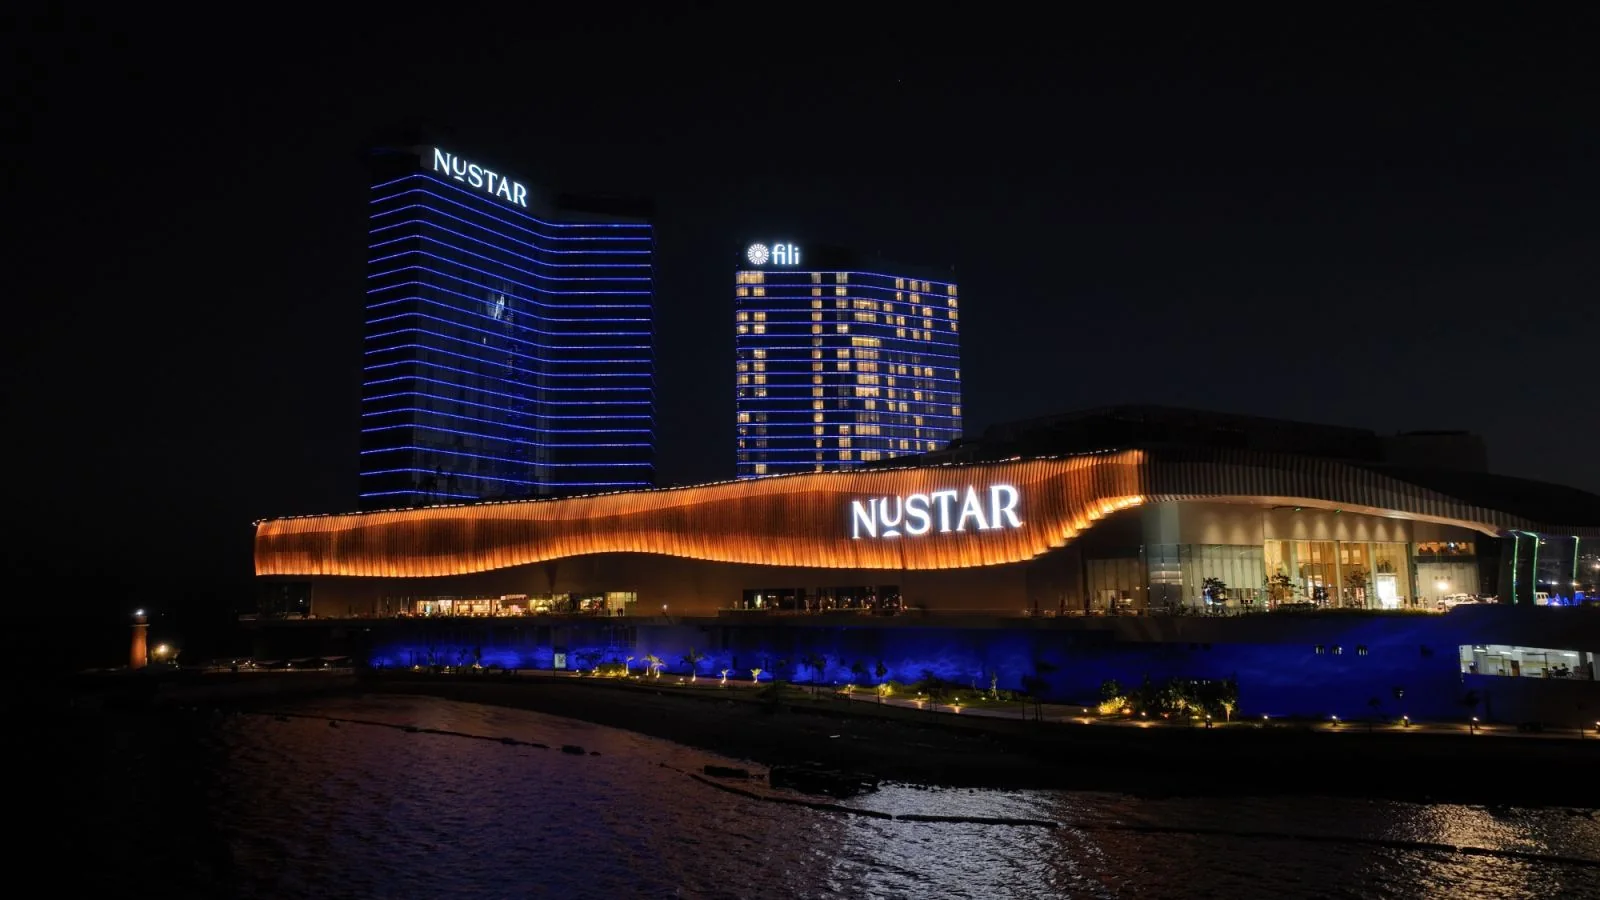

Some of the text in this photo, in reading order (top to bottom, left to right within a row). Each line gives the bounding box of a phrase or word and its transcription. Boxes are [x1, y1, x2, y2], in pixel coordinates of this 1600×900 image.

[433, 147, 528, 208] NUSTAR
[771, 243, 800, 265] fili
[851, 484, 1023, 540] NUSTAR
